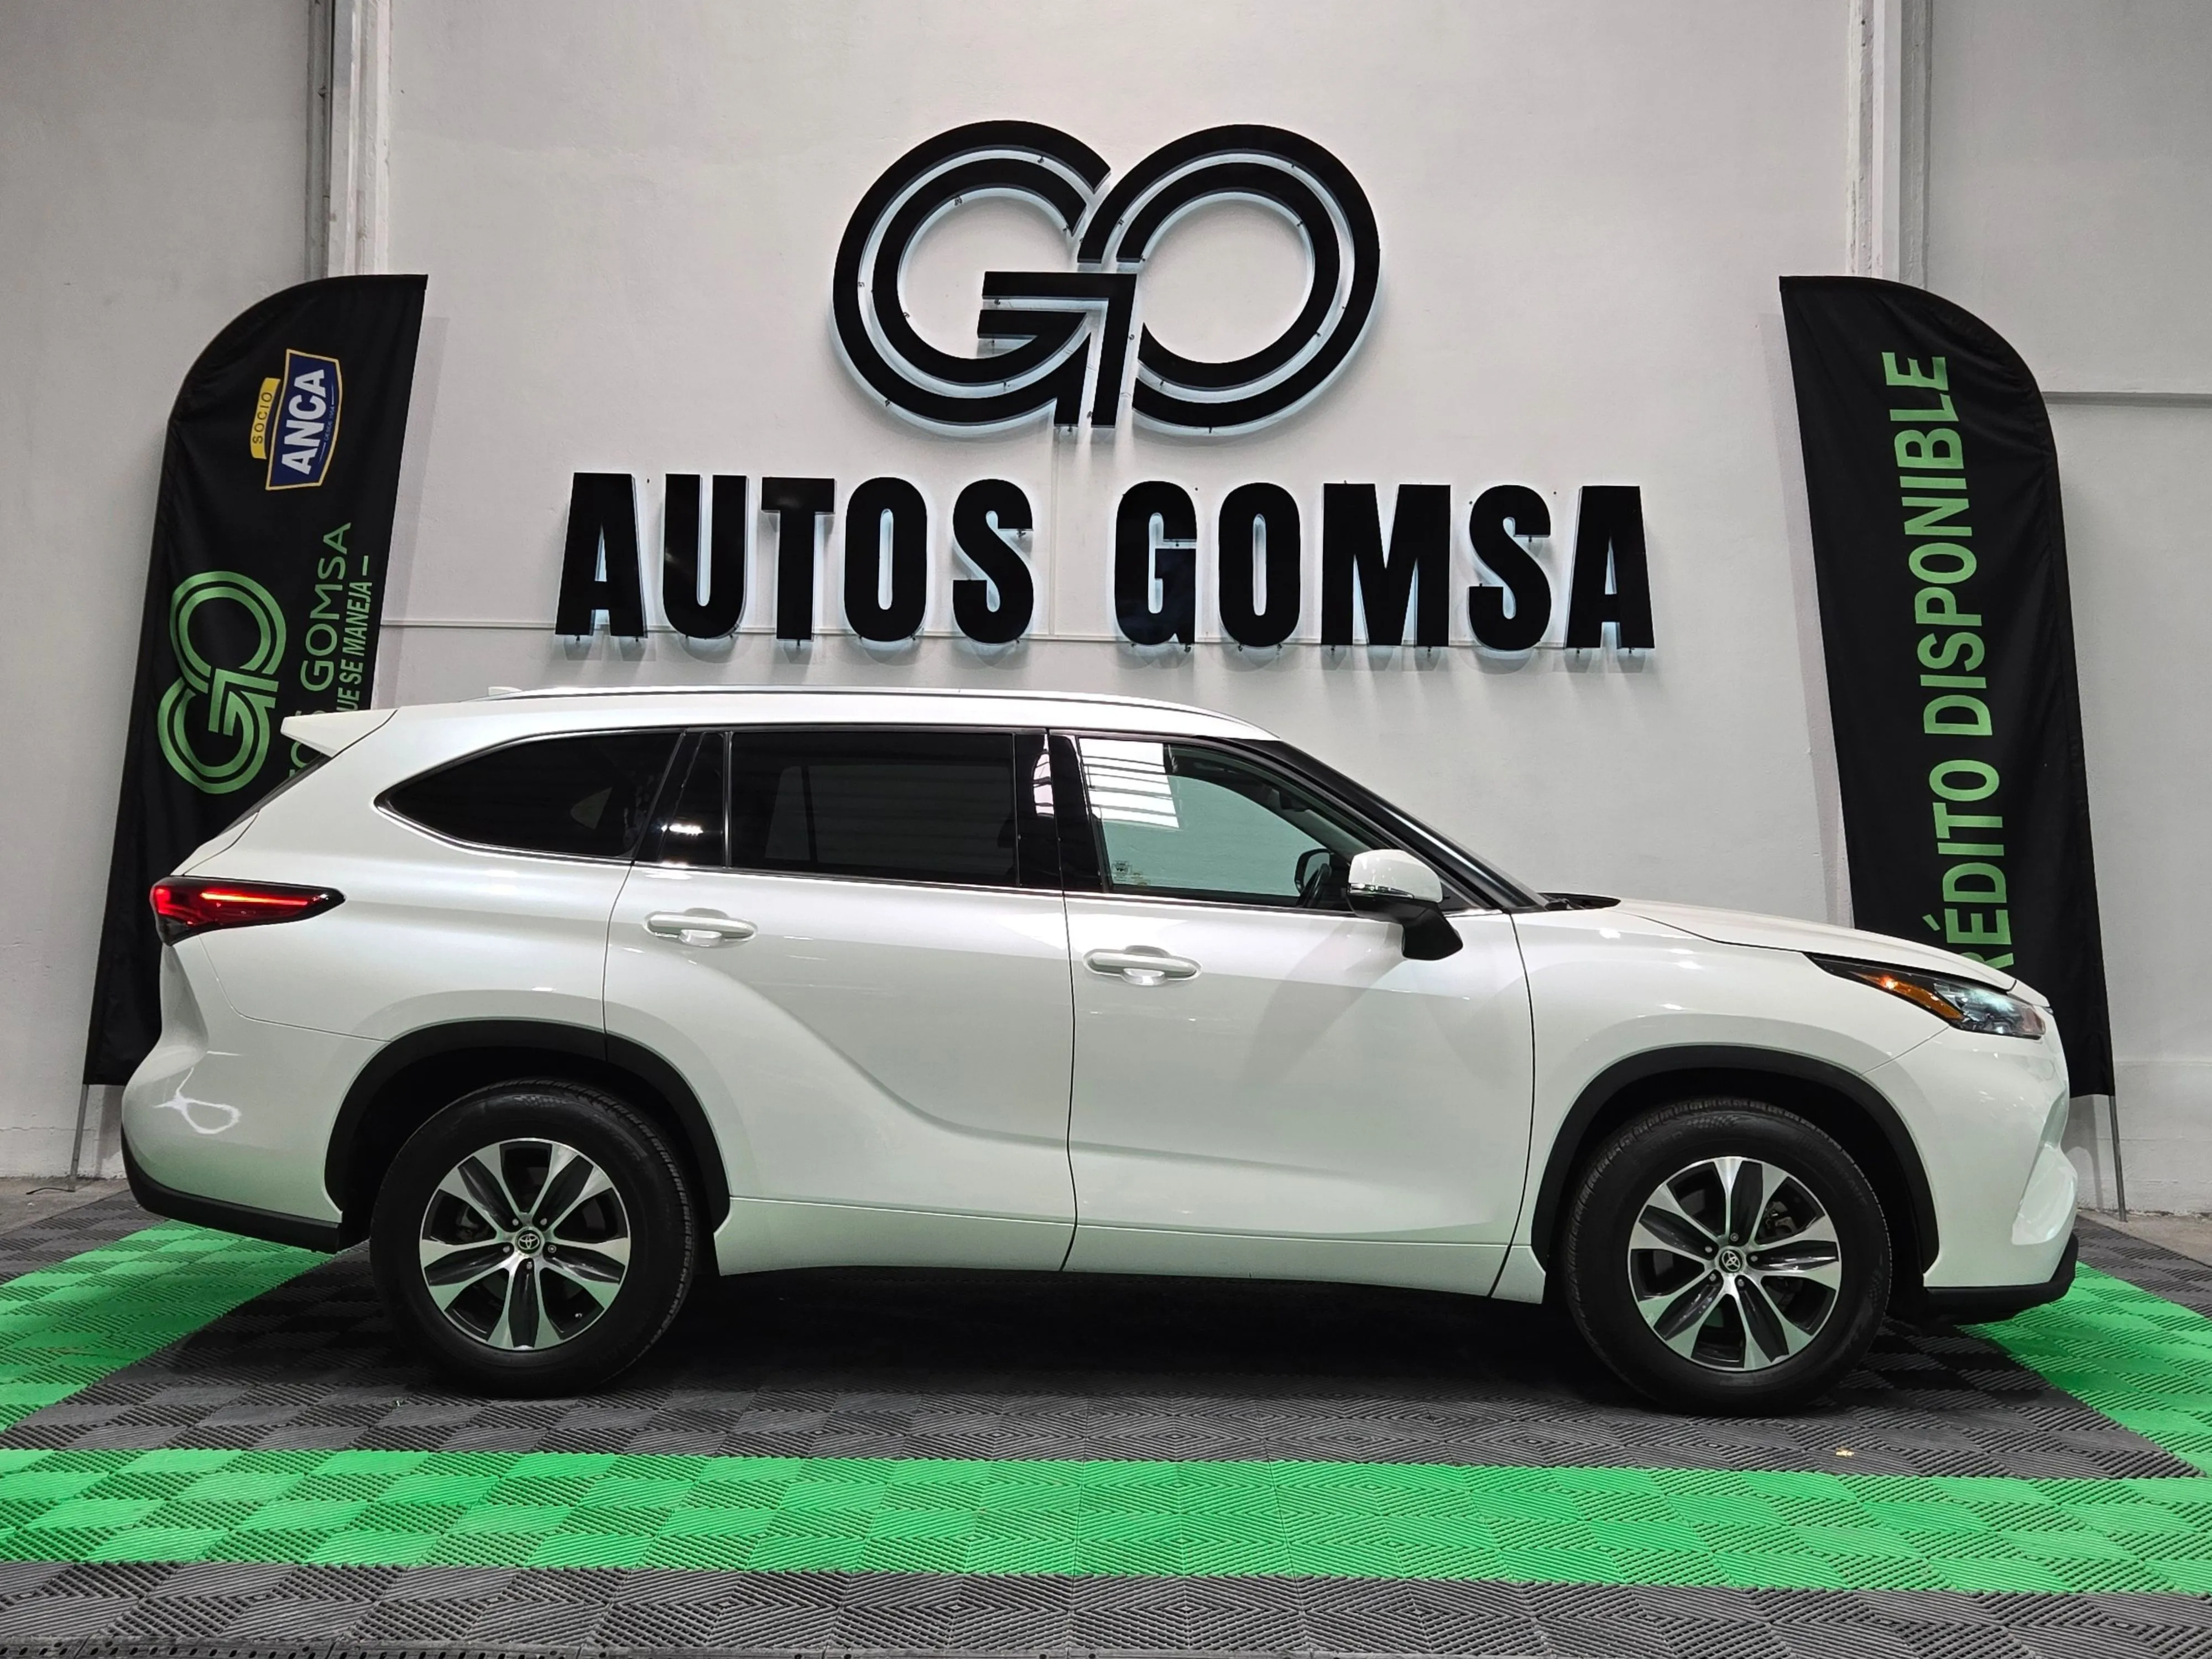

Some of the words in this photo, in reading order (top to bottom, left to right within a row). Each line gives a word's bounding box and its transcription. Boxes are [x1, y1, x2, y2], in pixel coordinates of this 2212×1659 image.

[252, 392, 273, 445] SOCIO
[281, 369, 327, 474] ANCA
[555, 472, 1034, 646] AUTOS
[1114, 480, 1656, 653] GOMSA
[1881, 352, 1994, 736] DISPONIBLE
[300, 522, 352, 692] GOMSA
[342, 581, 373, 657] MANEJA
[339, 659, 363, 685] SE
